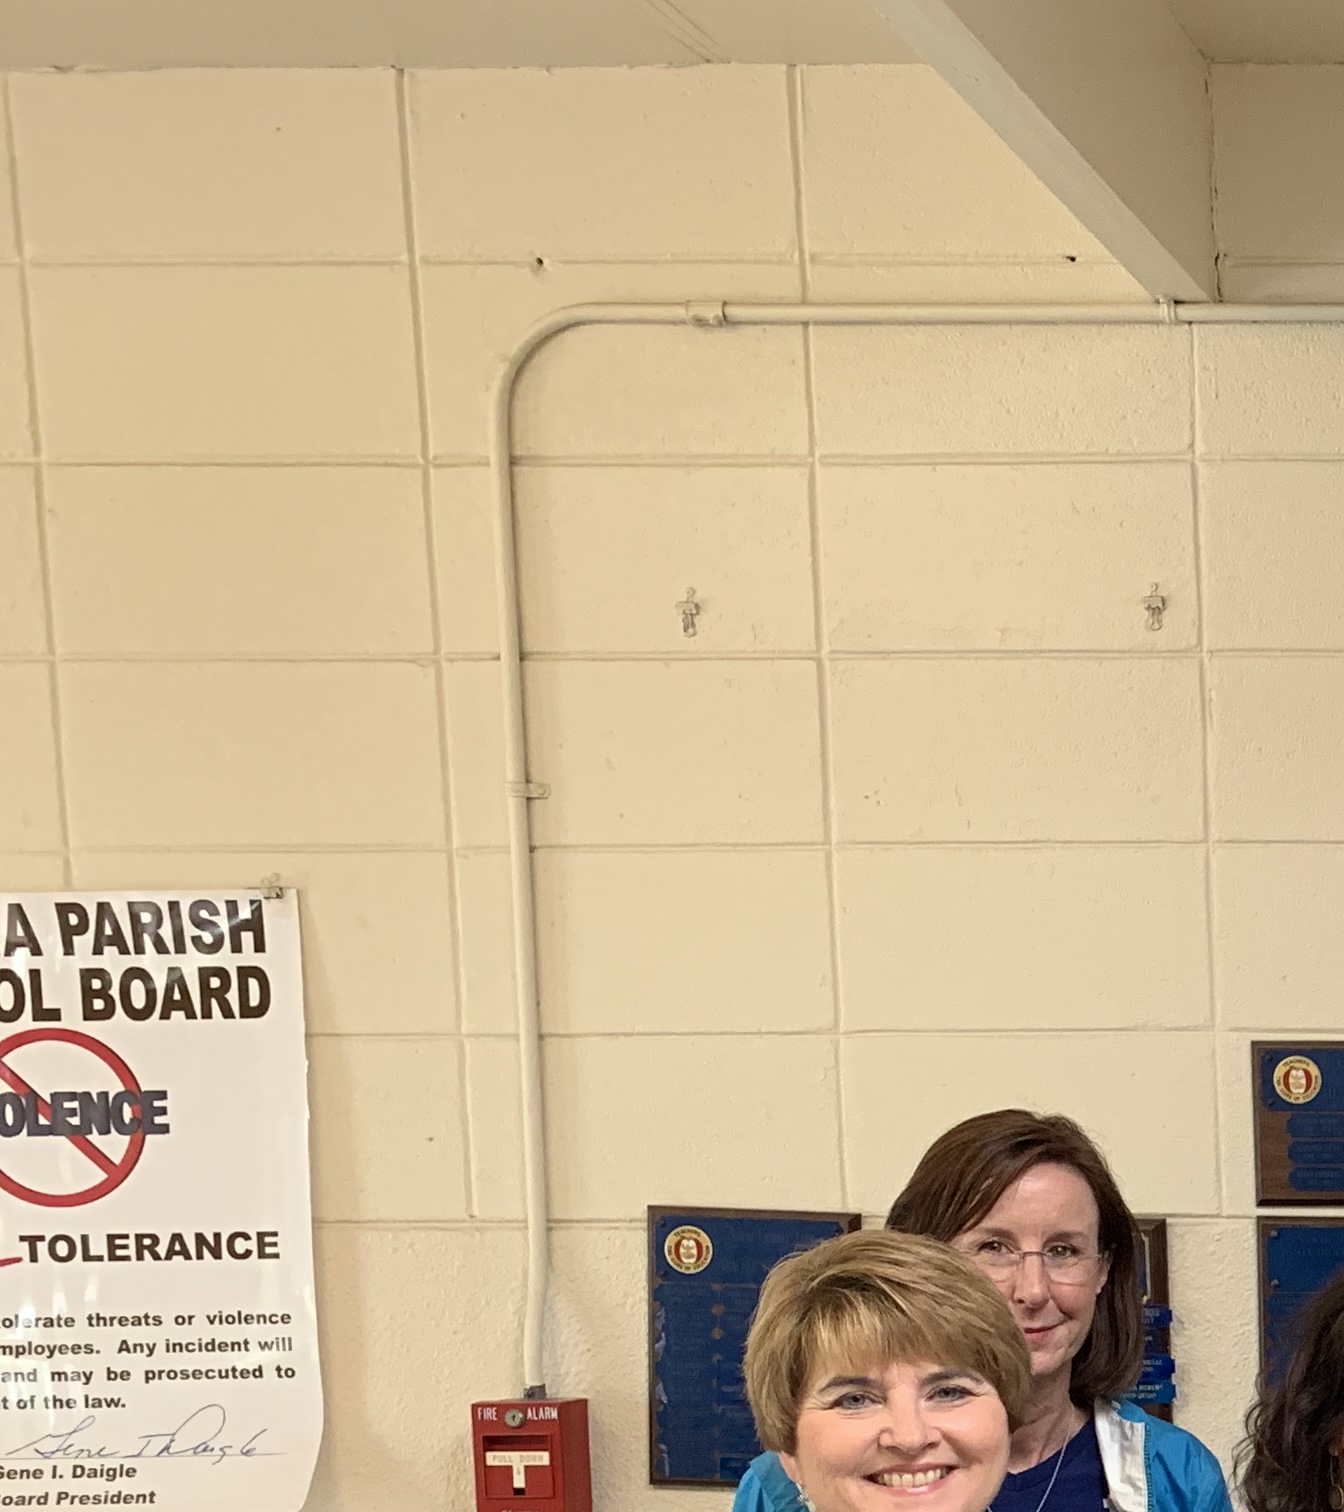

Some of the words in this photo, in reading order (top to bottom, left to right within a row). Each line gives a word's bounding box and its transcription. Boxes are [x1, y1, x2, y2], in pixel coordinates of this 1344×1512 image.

[54, 898, 267, 956] PARISH
[79, 965, 271, 1021] BOARD
[19, 1231, 281, 1263] TOLERANCE
[0, 1313, 76, 1329] olerate
[86, 1312, 164, 1328] threats
[174, 1313, 195, 1327] or
[206, 1310, 292, 1326] violence
[117, 1338, 157, 1358] Any
[165, 1336, 250, 1354] incident
[258, 1336, 293, 1353] will
[0, 1367, 38, 1383] and
[51, 1370, 93, 1386] may
[106, 1367, 131, 1382] be
[144, 1364, 264, 1384] prosecuted
[275, 1363, 296, 1379] to
[16, 1395, 36, 1410] of
[43, 1395, 77, 1410] the
[84, 1393, 126, 1409] law.
[477, 1407, 498, 1420] FIRE
[526, 1406, 559, 1420] ALARM
[492, 1454, 514, 1464] PULL
[519, 1454, 545, 1464] DOWN
[52, 1464, 65, 1480] I.
[72, 1463, 137, 1481] Daigle
[0, 1491, 49, 1506] oard
[56, 1490, 156, 1506] President
